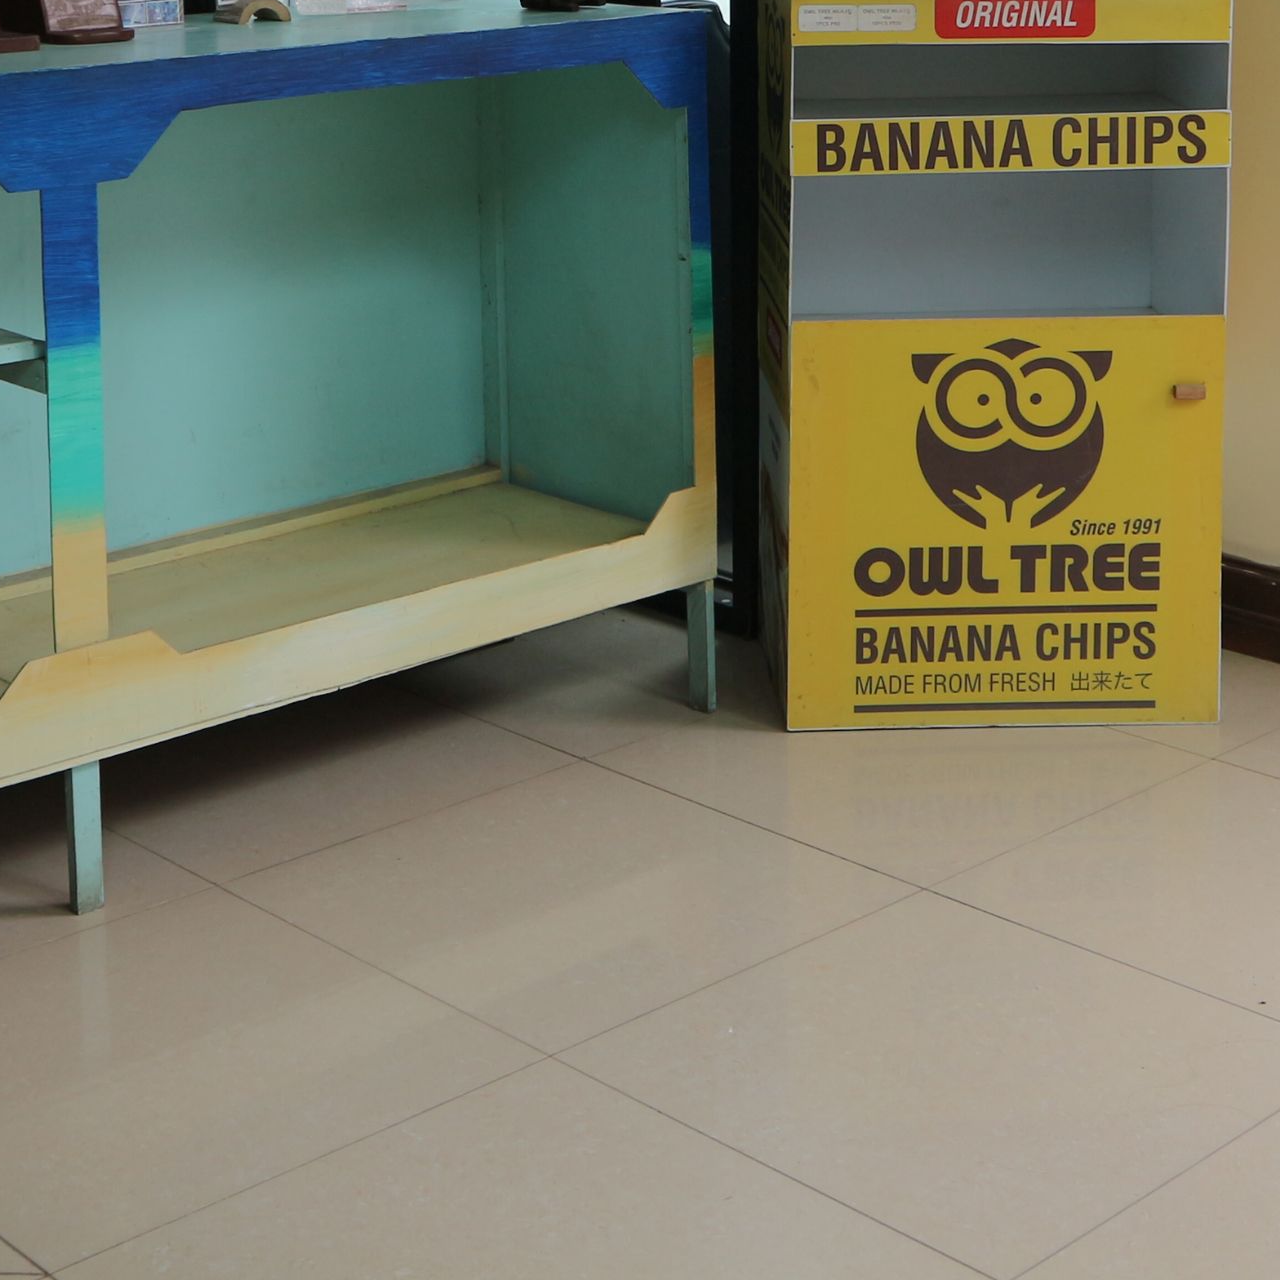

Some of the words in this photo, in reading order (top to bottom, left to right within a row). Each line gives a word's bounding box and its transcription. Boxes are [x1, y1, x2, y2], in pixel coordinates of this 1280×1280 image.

[955, 0, 1078, 30] ORIGINAL
[815, 119, 1034, 174] BANANA
[1051, 113, 1208, 168] CHIPS
[1069, 519, 1116, 537] Since
[1122, 517, 1163, 536] 1991
[853, 544, 1000, 598] OWL
[1009, 542, 1162, 594] TREE
[854, 624, 1022, 666] BANANA
[1035, 620, 1158, 662] CHIPS
[854, 673, 916, 696] MADE
[921, 672, 983, 695] FROM
[988, 671, 1056, 693] FRESH
[1070, 670, 1153, 693] 出来たて
